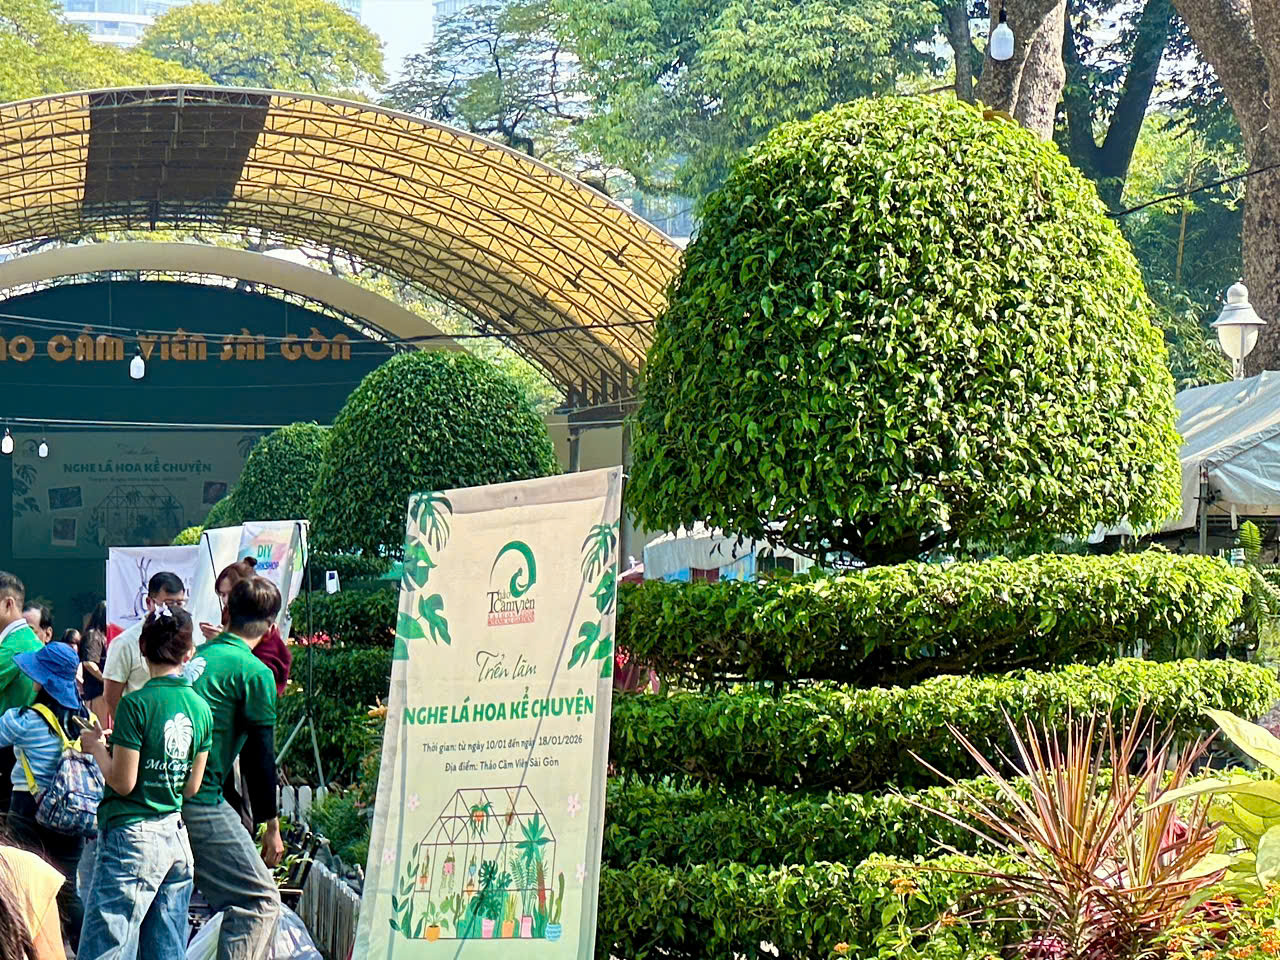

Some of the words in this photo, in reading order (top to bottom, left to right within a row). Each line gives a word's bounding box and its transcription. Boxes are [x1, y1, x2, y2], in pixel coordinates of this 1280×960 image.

[136, 327, 207, 360] VIÊN
[220, 327, 265, 360] SÀI
[280, 327, 351, 360] GÒN
[63, 463, 96, 473] NGHE
[98, 459, 113, 473] LÁ
[115, 463, 142, 473] HOA
[162, 460, 212, 475] CHUYỆN
[258, 544, 272, 558] DIY
[512, 654, 536, 680] lãm
[402, 706, 447, 725] NGHE
[451, 696, 470, 723] LÁ
[473, 702, 507, 722] HOA
[510, 687, 528, 719] KỂ
[531, 688, 594, 722] CHUYỆN
[423, 742, 438, 752] Thời
[439, 743, 456, 754] gian:
[468, 741, 485, 753] ngày
[486, 739, 506, 749] 10/01
[539, 735, 583, 745] 18/01/2026
[530, 757, 541, 767] Sài
[543, 756, 559, 766] Gòn
